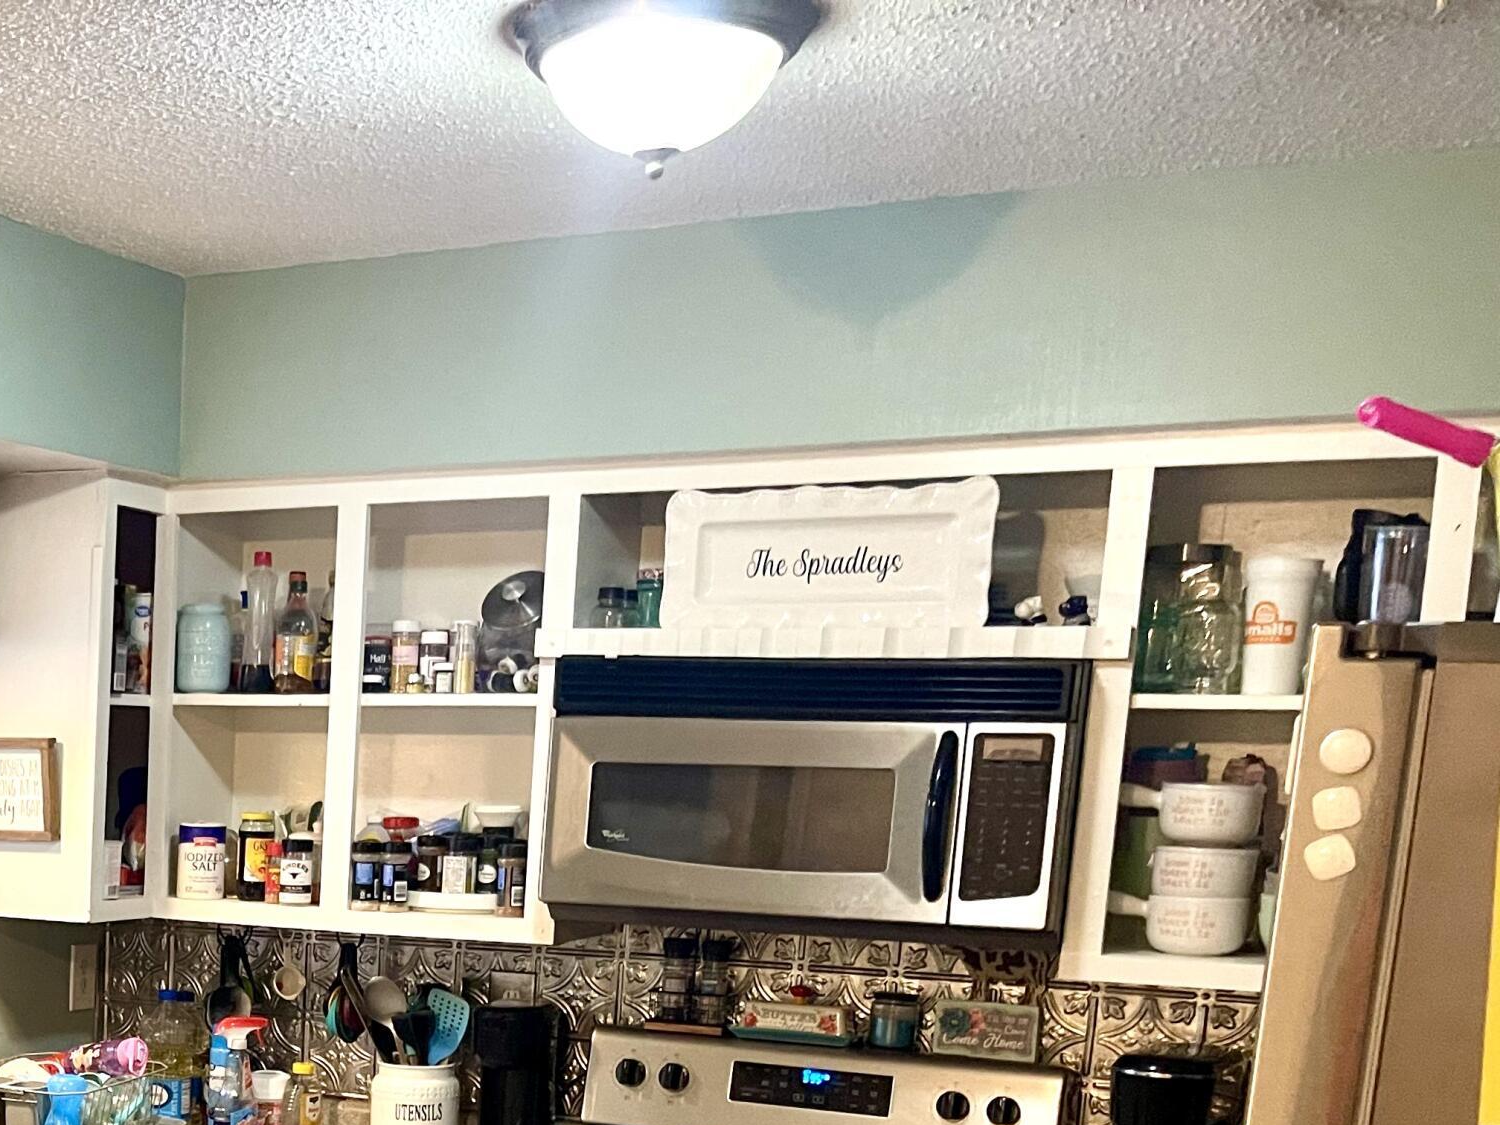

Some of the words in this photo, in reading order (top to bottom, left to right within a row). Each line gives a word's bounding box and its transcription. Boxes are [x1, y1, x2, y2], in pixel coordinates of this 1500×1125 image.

[746, 547, 788, 579] The
[792, 546, 904, 585] Spradleys
[184, 852, 226, 863] IODIZED
[191, 862, 219, 873] SALT
[983, 1033, 1026, 1050] Home
[395, 1102, 443, 1122] UTENSILS
